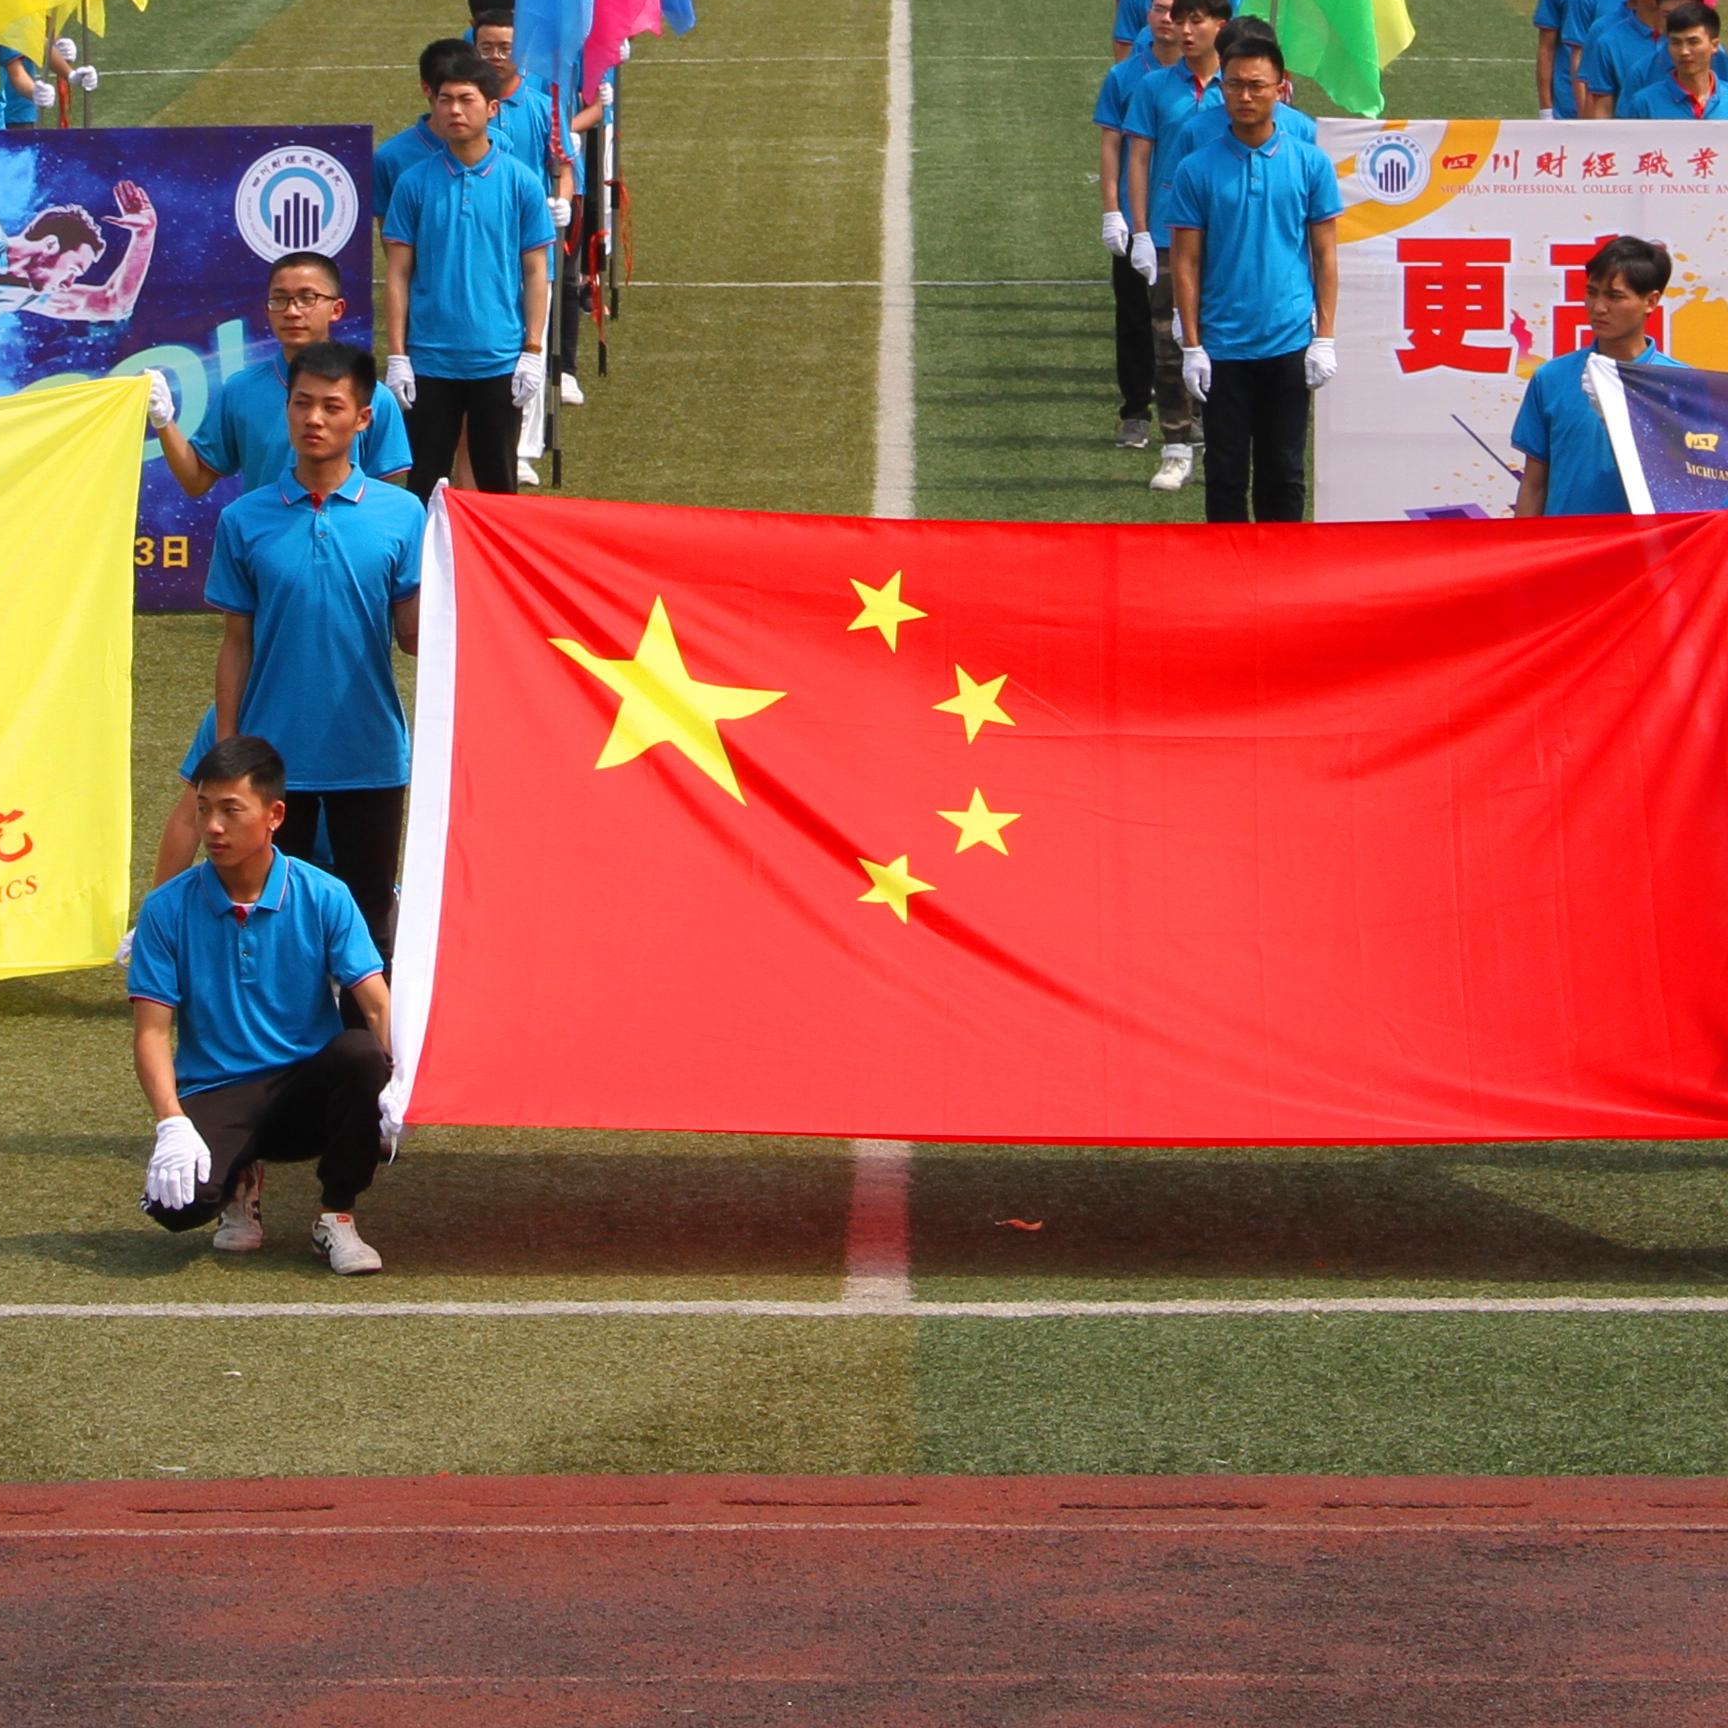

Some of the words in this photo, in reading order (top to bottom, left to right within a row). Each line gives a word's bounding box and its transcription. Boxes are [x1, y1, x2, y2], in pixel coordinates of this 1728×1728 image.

[1493, 184, 1576, 194] PROFESSIONAL
[1582, 184, 1633, 194] COLLEGE
[1639, 184, 1654, 194] OF
[1660, 184, 1709, 194] FINANCE
